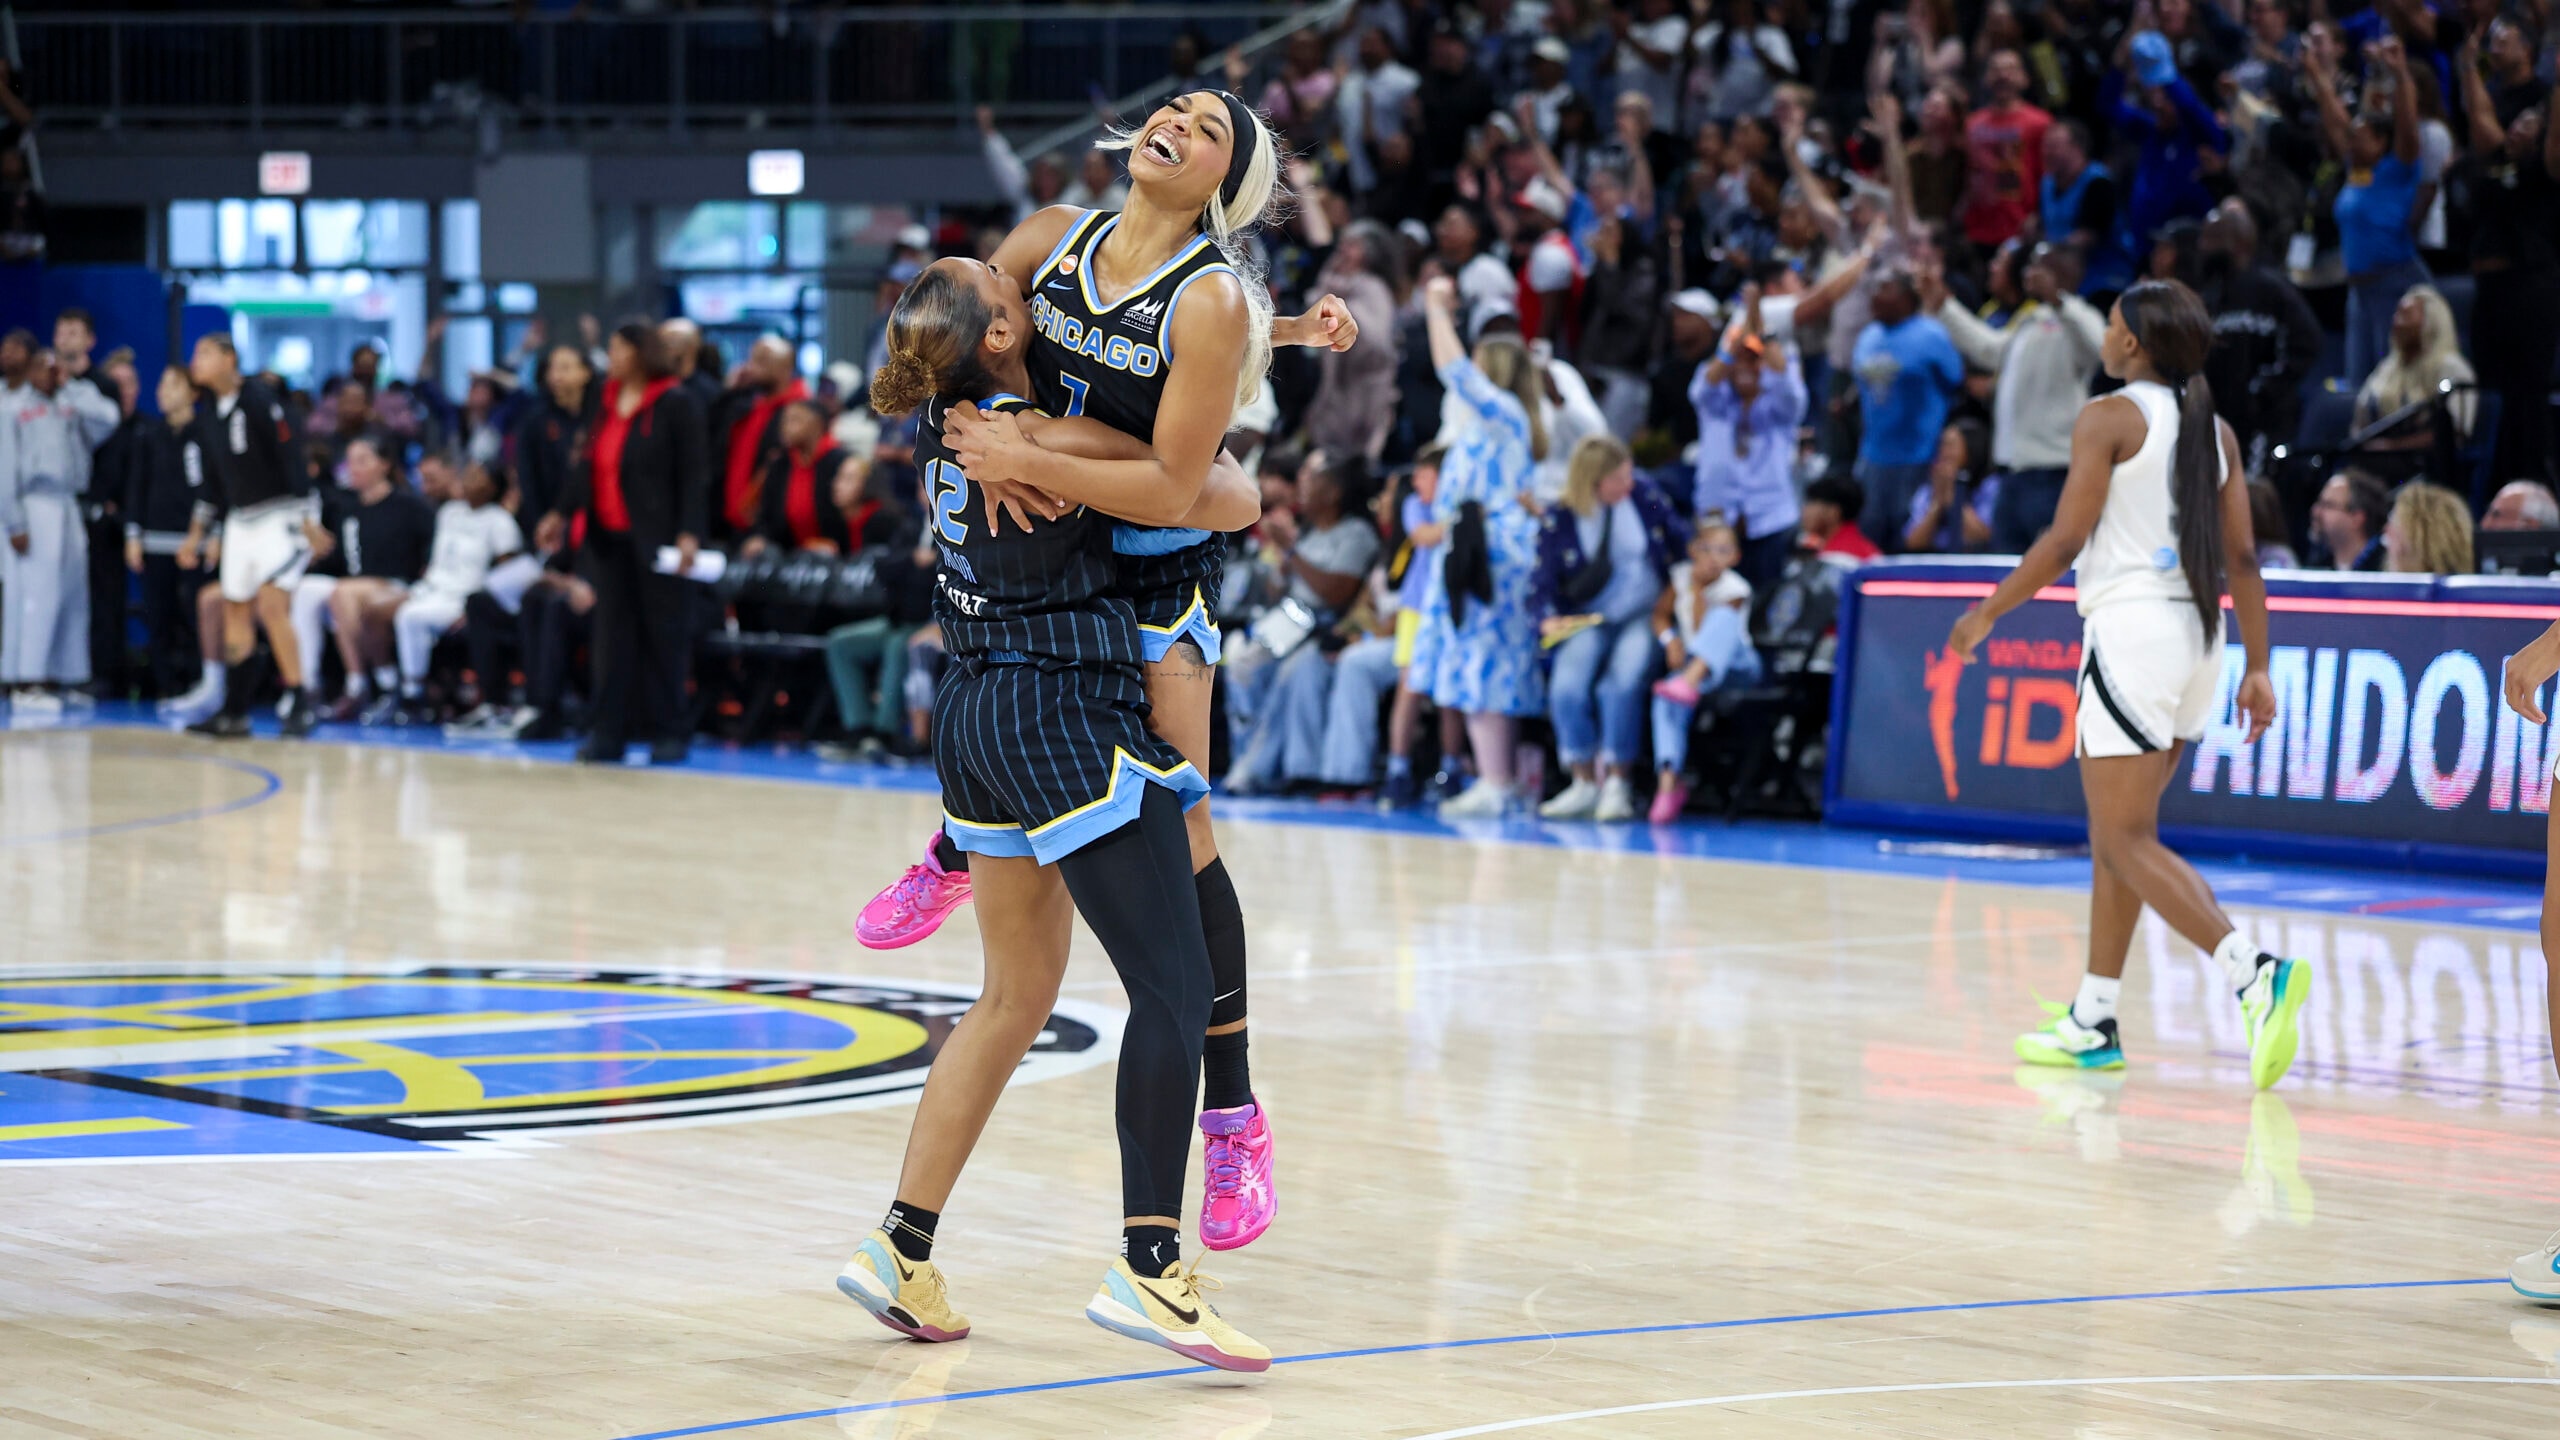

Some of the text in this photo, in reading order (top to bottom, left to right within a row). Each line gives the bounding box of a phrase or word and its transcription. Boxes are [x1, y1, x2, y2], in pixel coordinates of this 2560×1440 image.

[1032, 292, 1160, 378] CHICAGO
[1123, 311, 1156, 326] MAGELLAN
[1060, 370, 1091, 418] 7
[925, 457, 969, 546] 12
[947, 586, 989, 617] AT&T
[1979, 675, 2078, 770] iD
[2189, 643, 2560, 815] ANDO
